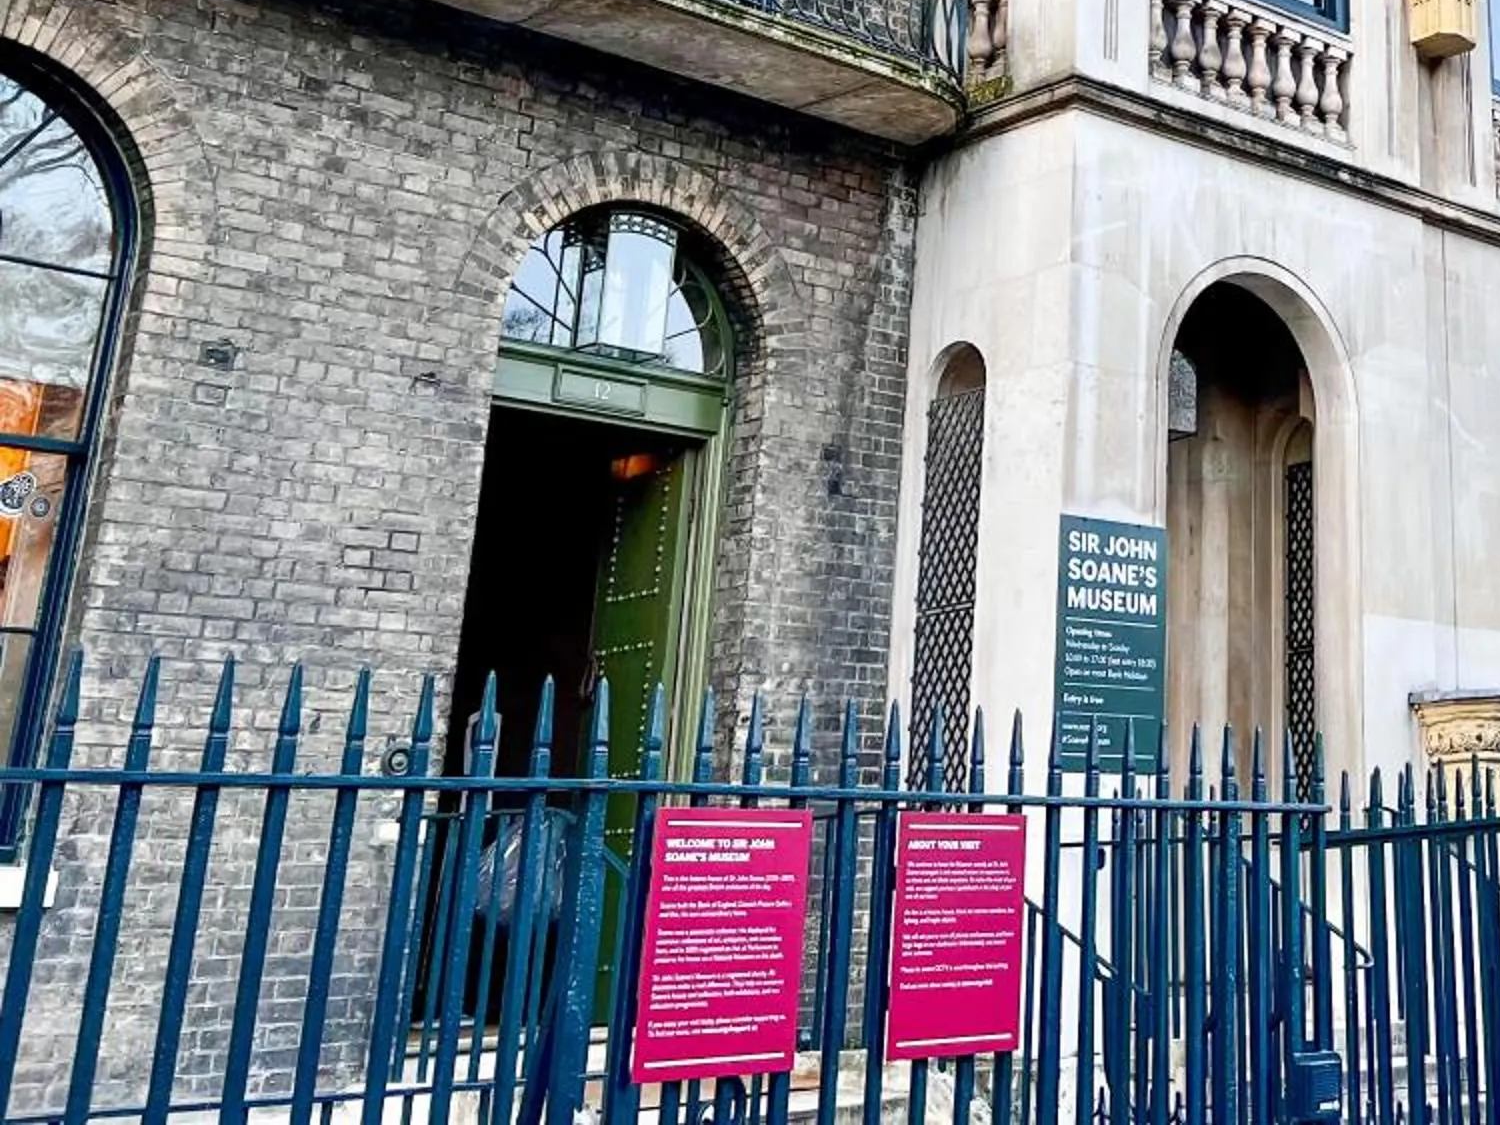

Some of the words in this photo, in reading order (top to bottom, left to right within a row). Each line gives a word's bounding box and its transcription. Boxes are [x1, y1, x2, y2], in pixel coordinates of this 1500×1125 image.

[594, 382, 612, 400] 12
[1069, 530, 1101, 555] SIR
[1103, 535, 1157, 561] JOHN
[1067, 556, 1157, 589] SOANE'S
[1067, 585, 1157, 617] MUSEUM
[665, 838, 714, 849] WELCOME
[717, 838, 731, 849] TO
[907, 840, 936, 850] ABOUT
[708, 852, 750, 862] MUSEUM
